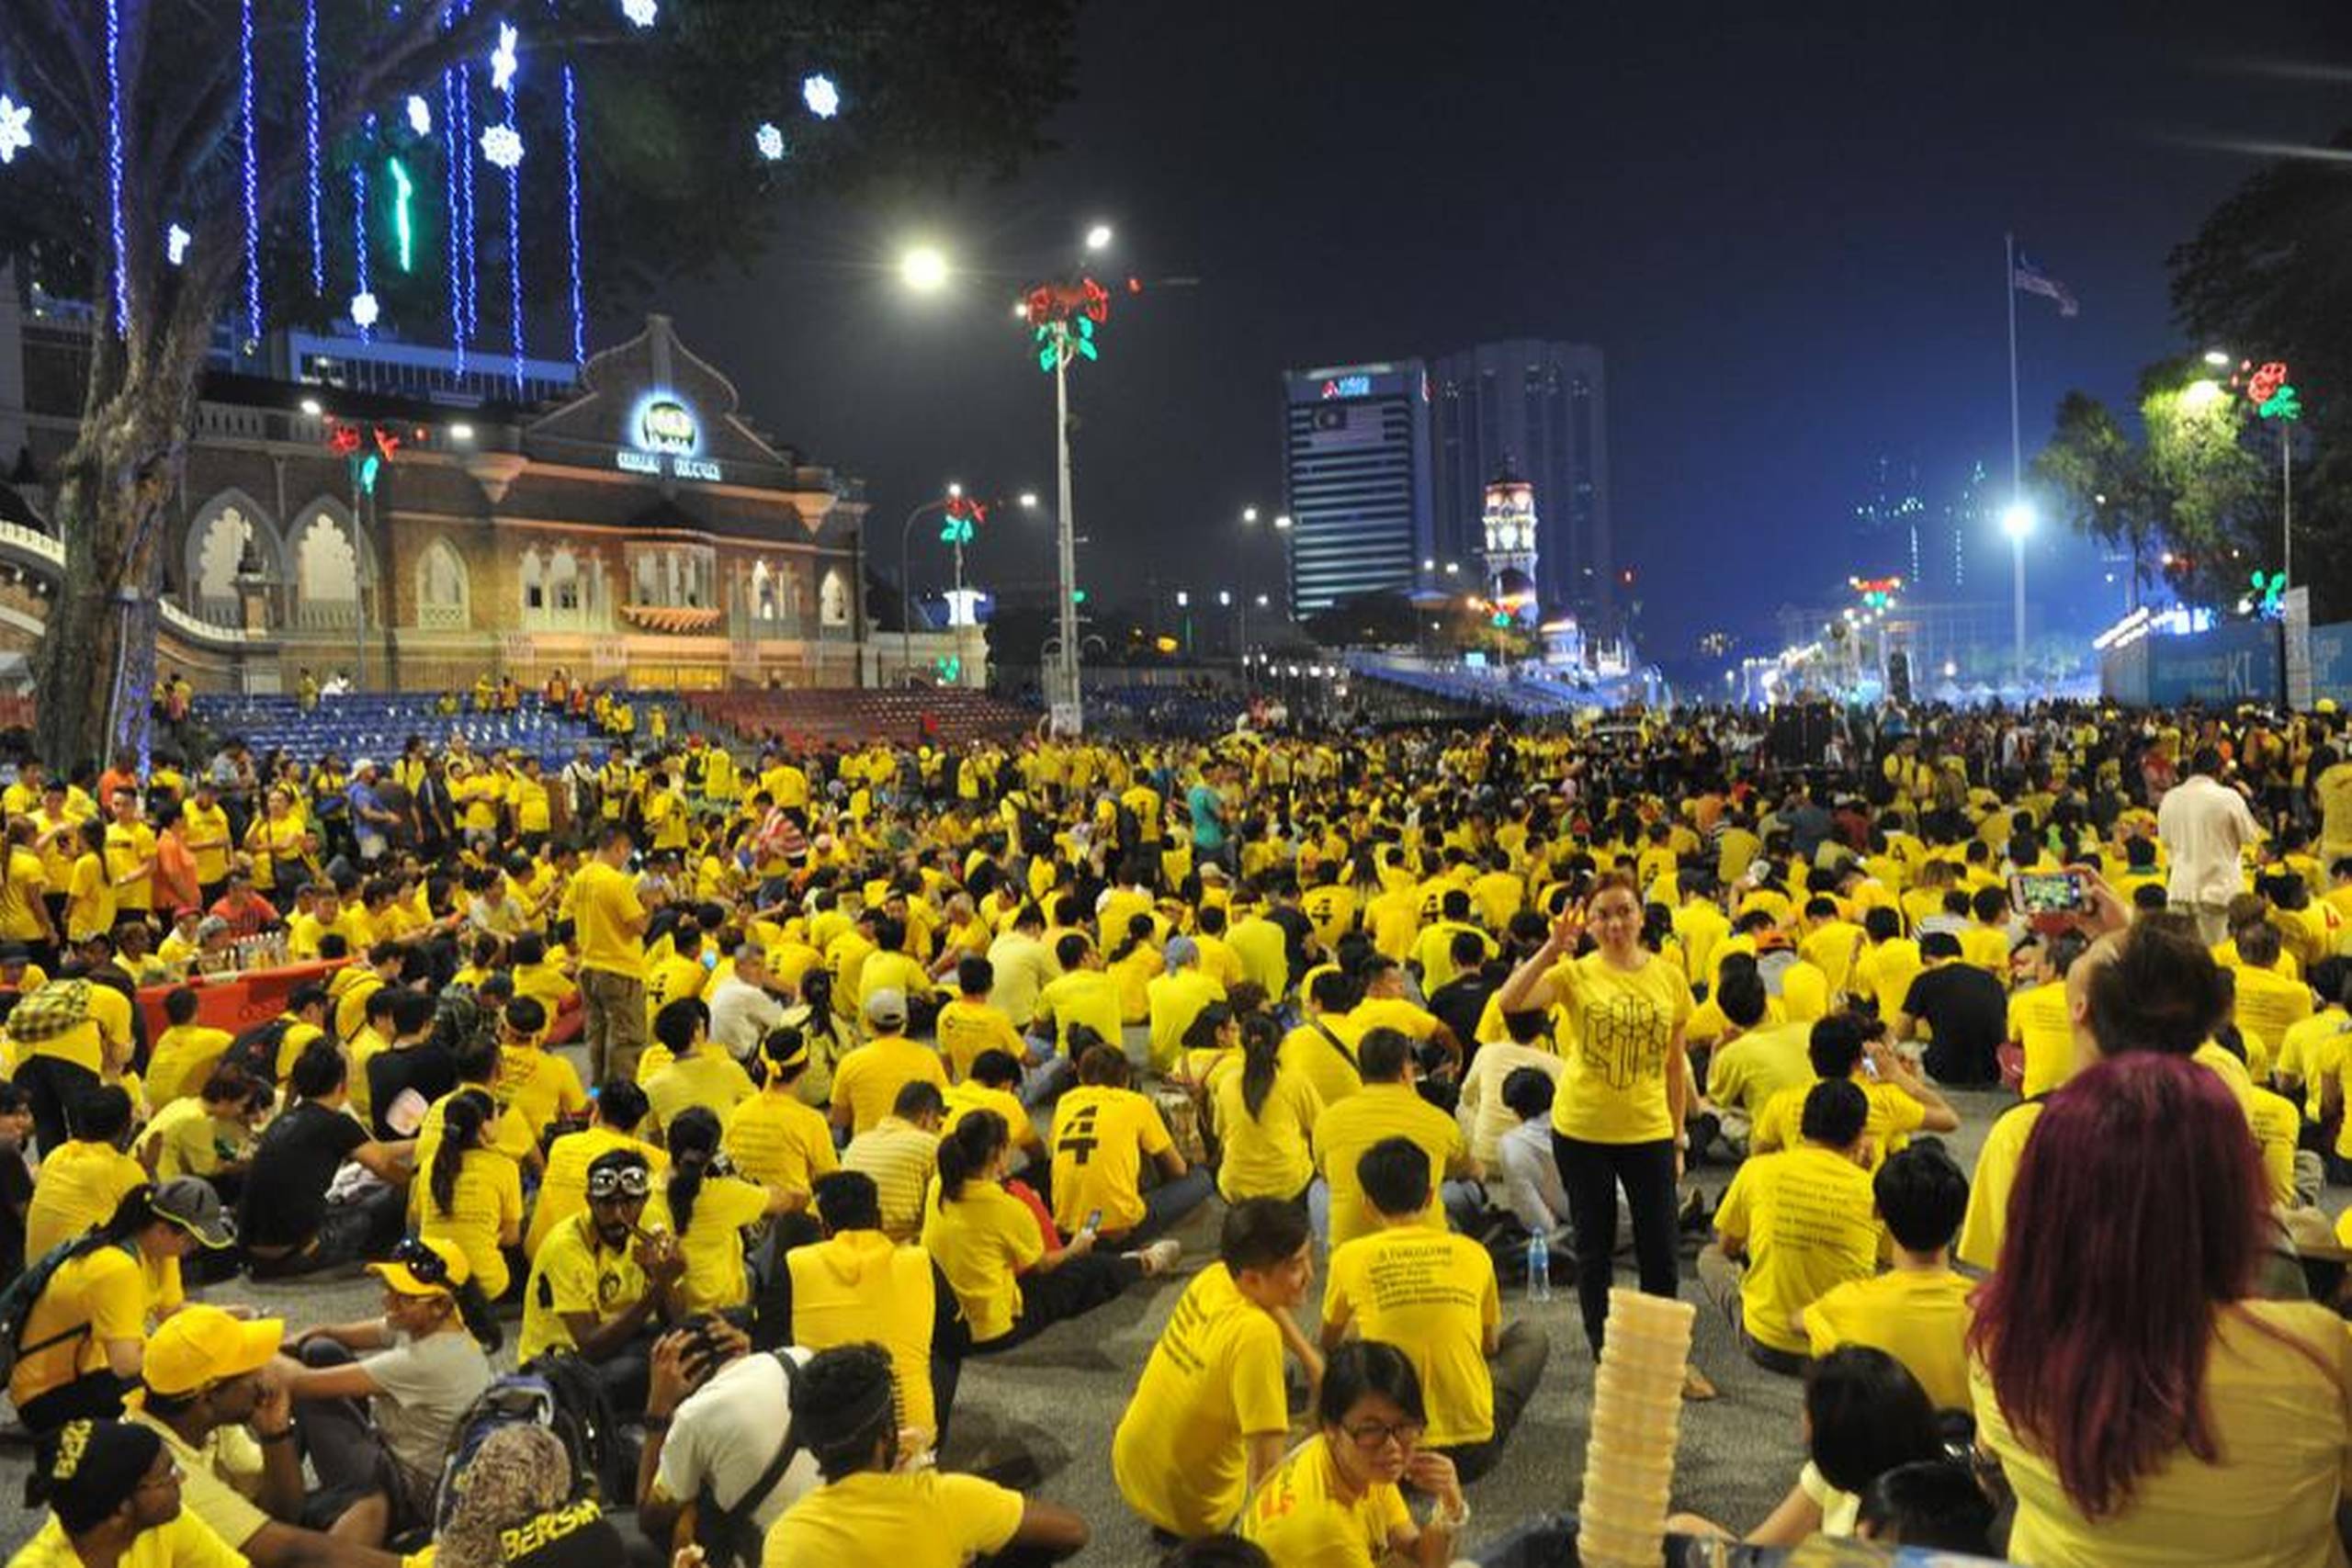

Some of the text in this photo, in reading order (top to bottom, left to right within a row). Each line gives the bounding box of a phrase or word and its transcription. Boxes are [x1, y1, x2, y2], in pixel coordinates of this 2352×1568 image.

[1310, 897, 1333, 926] 4
[1420, 894, 1440, 923] 4
[649, 973, 668, 1004] 4
[1057, 1104, 1100, 1166] 4
